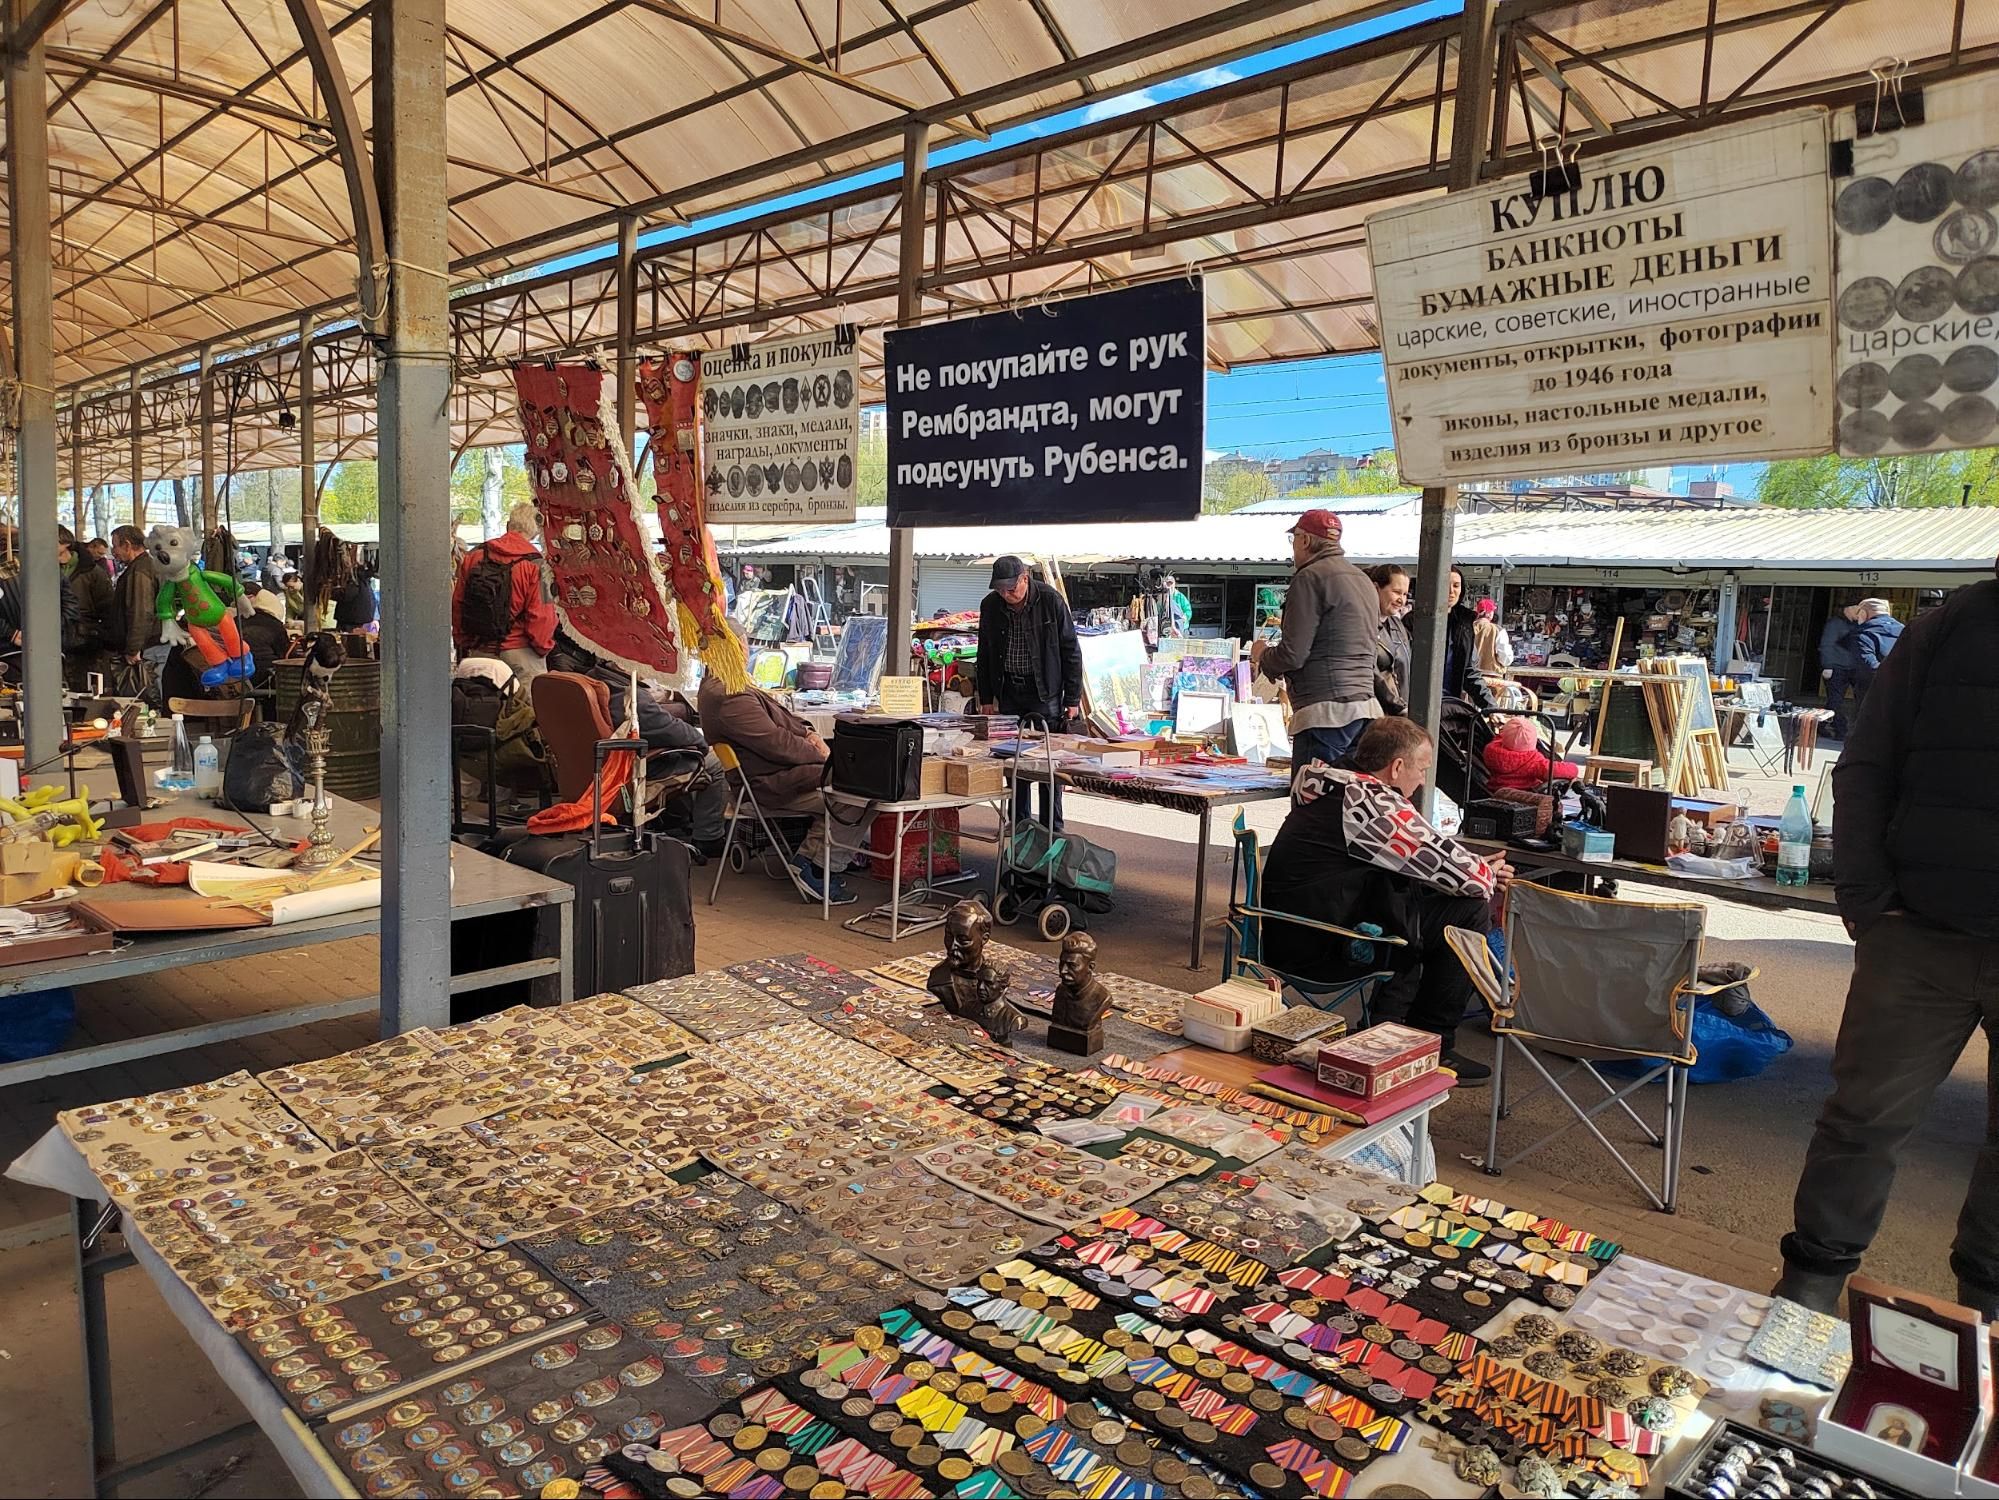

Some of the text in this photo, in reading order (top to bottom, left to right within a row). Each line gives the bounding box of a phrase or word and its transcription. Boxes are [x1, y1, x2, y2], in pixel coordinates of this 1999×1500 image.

[1491, 165, 1665, 235] КУПЛЮ
[1487, 212, 1684, 272] БАНКНОТЫ
[1421, 235, 1782, 317] БУМАЖНЫЕ ДЕНЬГИ
[1397, 273, 1810, 350] царские, советские, иностранные
[704, 355, 760, 379] оценка
[767, 354, 775, 367] и
[897, 332, 1187, 392] Не покупайте с рук
[1398, 308, 1822, 382] документы, открытки, фотографии
[1533, 361, 1673, 394] до 1946 года
[756, 424, 798, 438] знаки,
[801, 417, 852, 434] медали,
[903, 389, 1182, 439] Рембрандта, могут
[1445, 382, 1767, 433] иконы, настольные медали,
[1450, 417, 1762, 463] изделия из бронзы и другое
[897, 443, 1187, 489] подсунуть Рубенса.
[710, 502, 745, 511] изделия
[750, 501, 759, 510] из
[1602, 569, 1619, 578] 114
[1859, 572, 1879, 582] 113
[452, 1060, 476, 1073] 500
